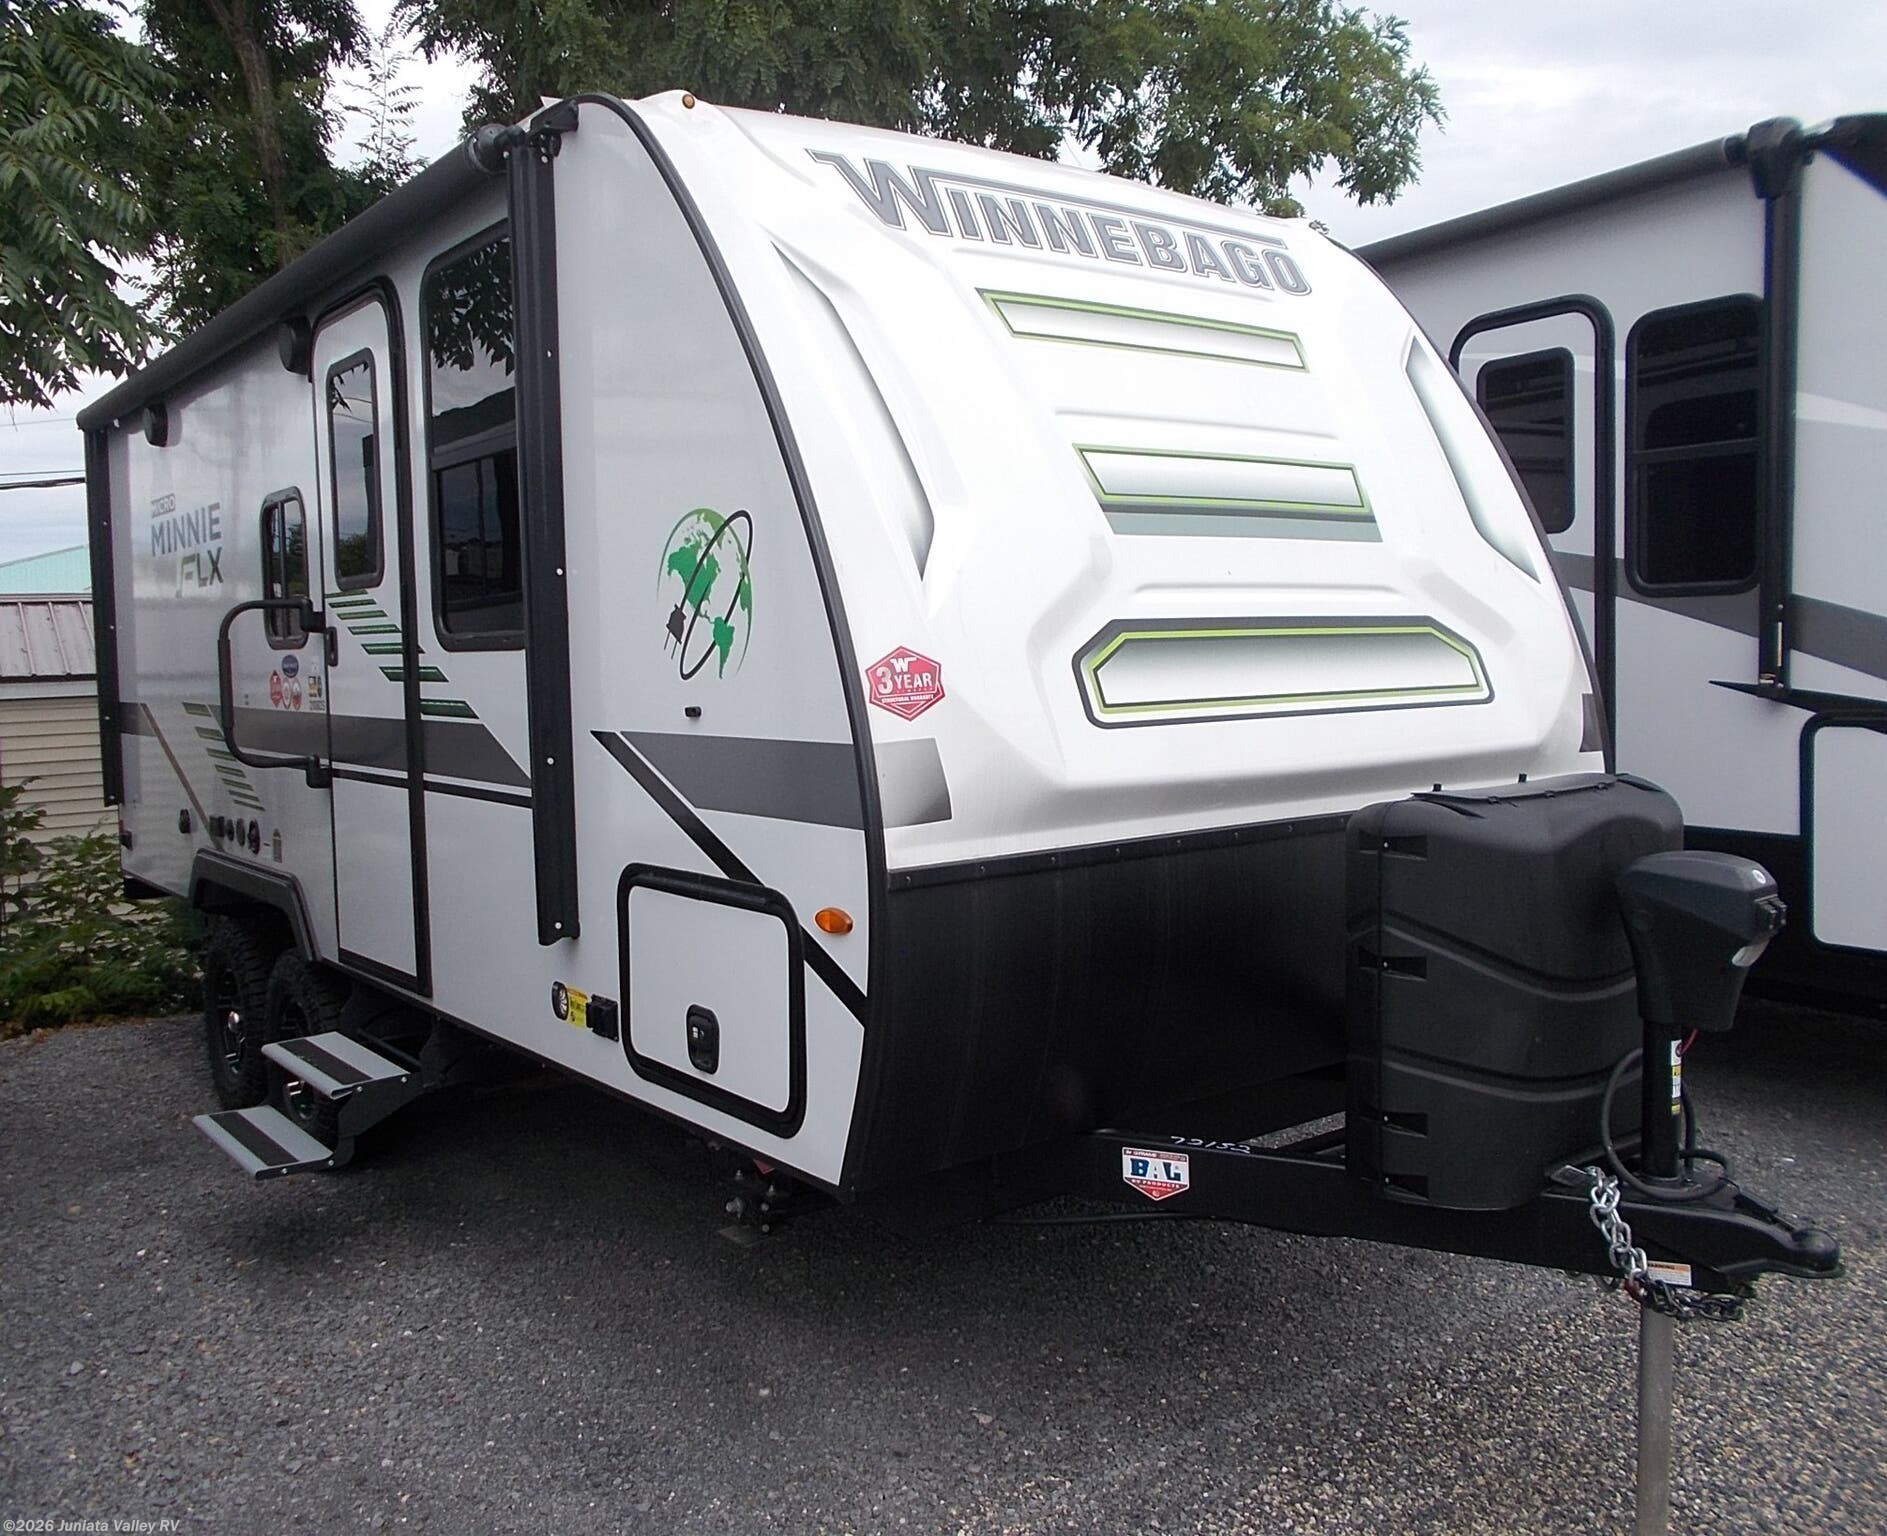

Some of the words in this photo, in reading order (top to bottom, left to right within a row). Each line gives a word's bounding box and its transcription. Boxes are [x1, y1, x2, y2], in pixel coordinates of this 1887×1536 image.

[804, 148, 1312, 296] WINNEBAGO
[151, 502, 222, 557] MINNIE
[175, 547, 224, 599] FLX
[876, 666, 894, 695] 3
[894, 672, 932, 689] YEAR
[1130, 1157, 1181, 1182] BAL
